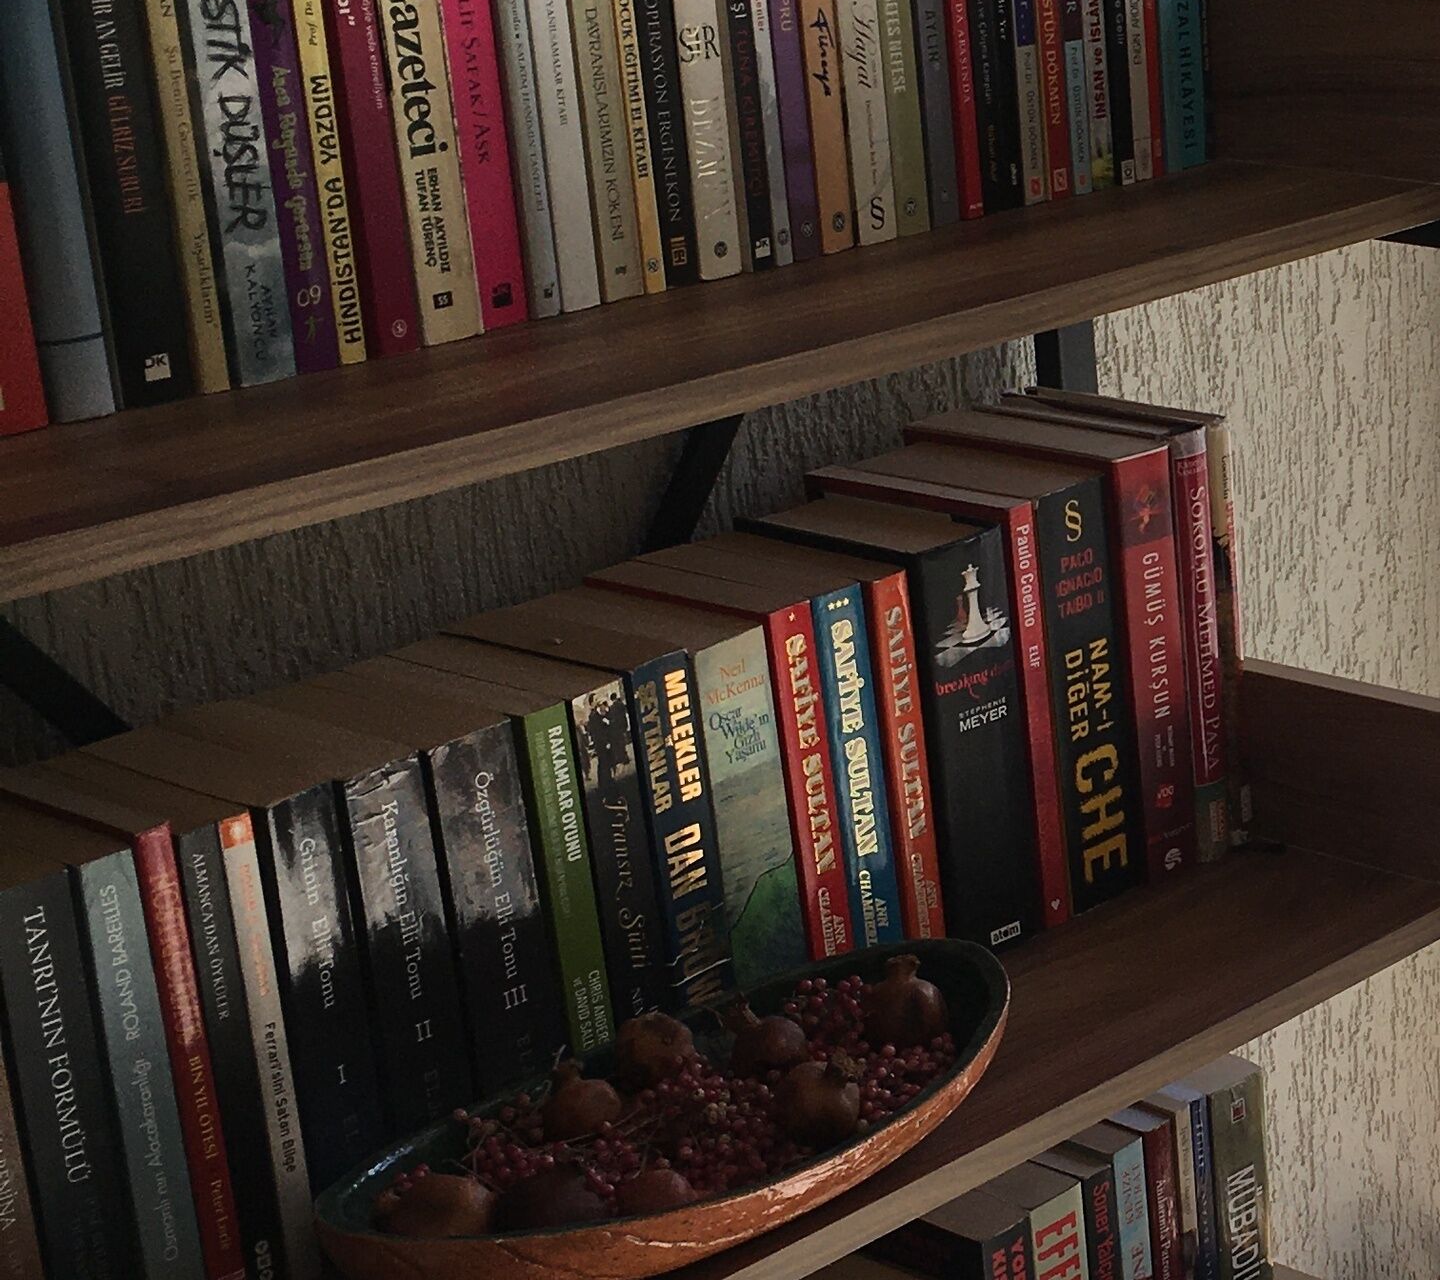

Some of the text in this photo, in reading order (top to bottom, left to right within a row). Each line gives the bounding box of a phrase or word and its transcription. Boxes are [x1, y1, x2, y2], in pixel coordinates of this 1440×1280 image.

[95, 18, 116, 41] AN
[97, 43, 123, 89] GELİR
[888, 42, 906, 95] NEFESE
[1045, 49, 1063, 128] DÖKMEN
[1091, 70, 1106, 119] İNSAN
[106, 95, 133, 154] GÜLRİZ
[628, 107, 643, 124] EL
[629, 127, 649, 179] KİTABI
[212, 95, 270, 234] DÜŞLER
[416, 170, 431, 212] TUFAN
[657, 110, 682, 223] ERGENEKON
[309, 75, 362, 345] HİNDİSTAN'DA YAZDIM
[425, 167, 450, 274] ERHAN AKYILDIZ
[1015, 524, 1041, 669] Paulo Coelho ELİF
[1140, 552, 1165, 626] GÜMÜŞ
[1146, 636, 1171, 720] KURŞUN
[1196, 601, 1218, 710] MEHMED
[883, 606, 926, 841] SAFİYE SULTAN
[958, 705, 1008, 733] MEYER
[1063, 648, 1090, 743] DİĞER
[663, 669, 703, 802] MELEKLER
[785, 632, 836, 875] SAFİYE SULTAN
[829, 619, 878, 858] SAFİYE SULTAN
[547, 725, 576, 811] RAKAMLAR
[563, 812, 582, 862] OYUNU
[1072, 742, 1128, 886] CHE
[473, 771, 520, 980] Özgürlüğün Elli Tonu
[663, 823, 709, 901] DAN
[310, 915, 330, 950] Elli
[398, 911, 420, 945] Elli
[831, 914, 846, 944] ANN
[874, 898, 889, 928] ANN
[318, 958, 337, 1009] Tonu
[404, 948, 425, 1000] Tonu
[22, 906, 92, 1185] TANRI'NIN FORMÜLÜ
[275, 1098, 296, 1139] Satan
[1092, 1181, 1111, 1233] Soner
